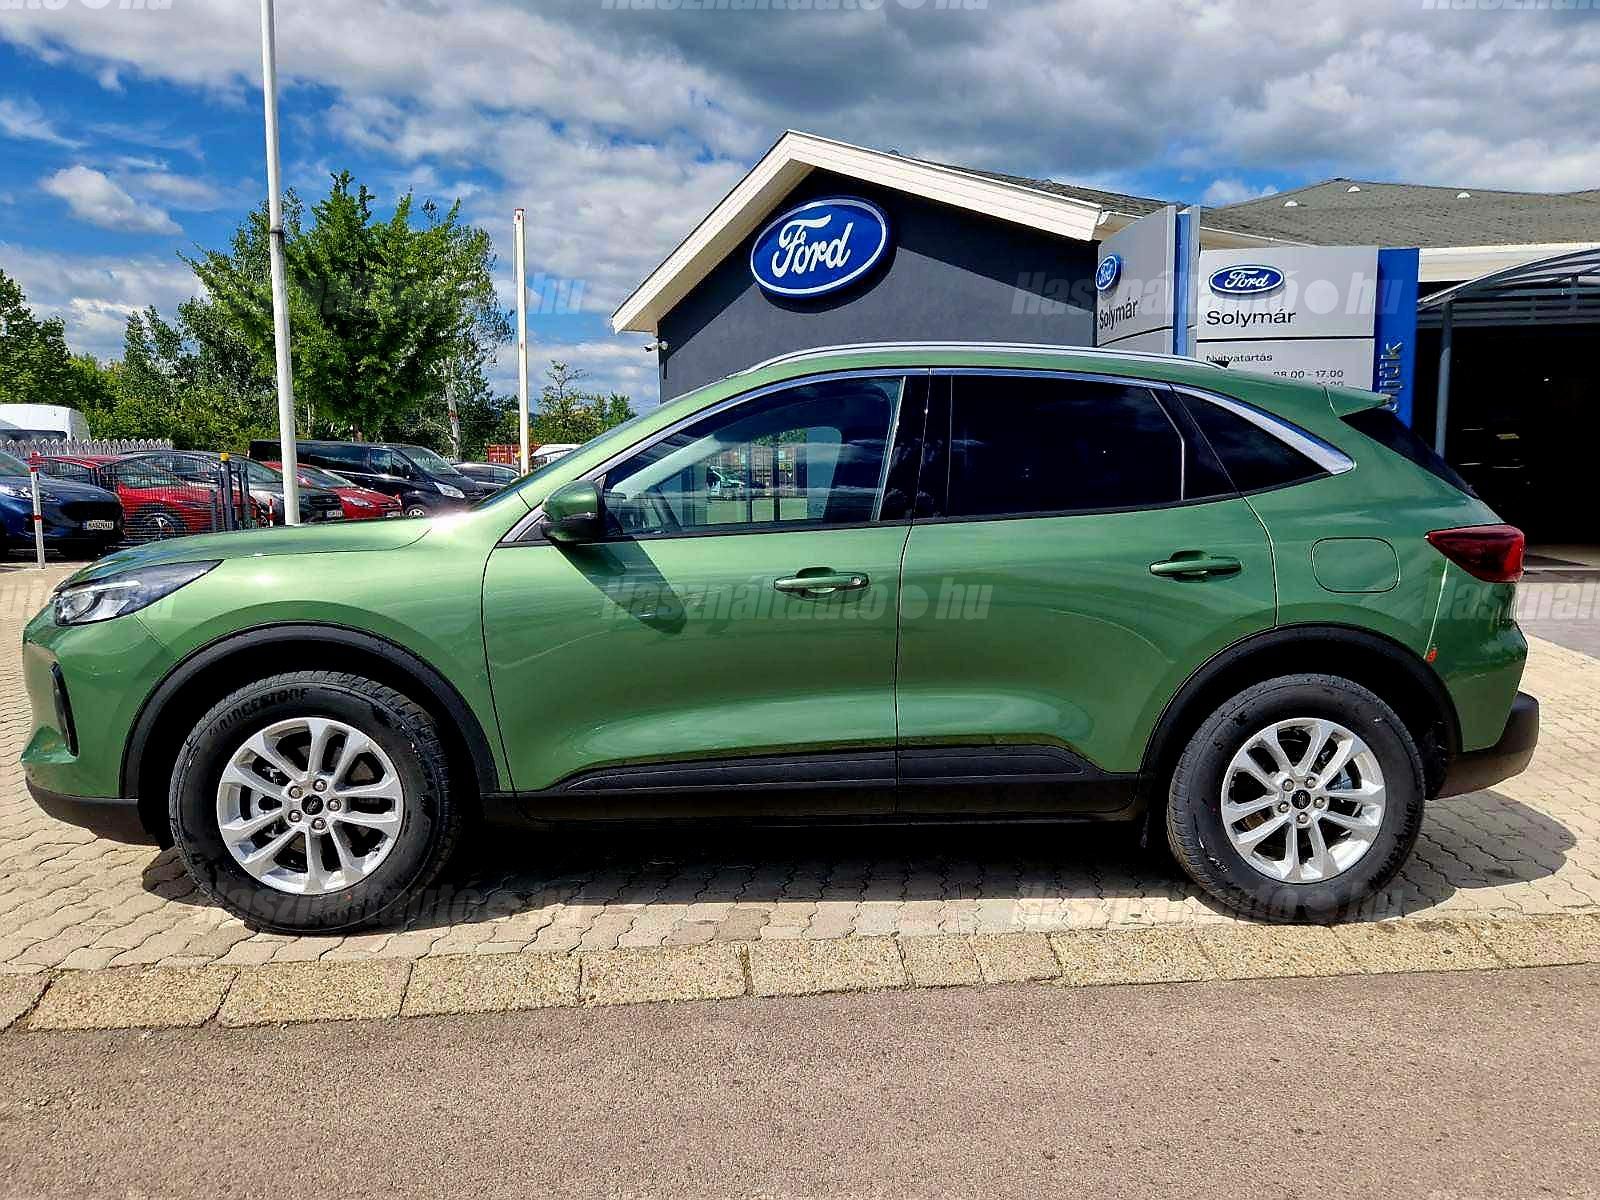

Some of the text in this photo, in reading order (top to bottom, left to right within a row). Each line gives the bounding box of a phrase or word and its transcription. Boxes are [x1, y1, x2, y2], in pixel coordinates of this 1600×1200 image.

[771, 214, 854, 278] Ford
[1224, 269, 1270, 288] Ford
[1099, 296, 1138, 330] Solymár
[1206, 308, 1297, 328] Solymár
